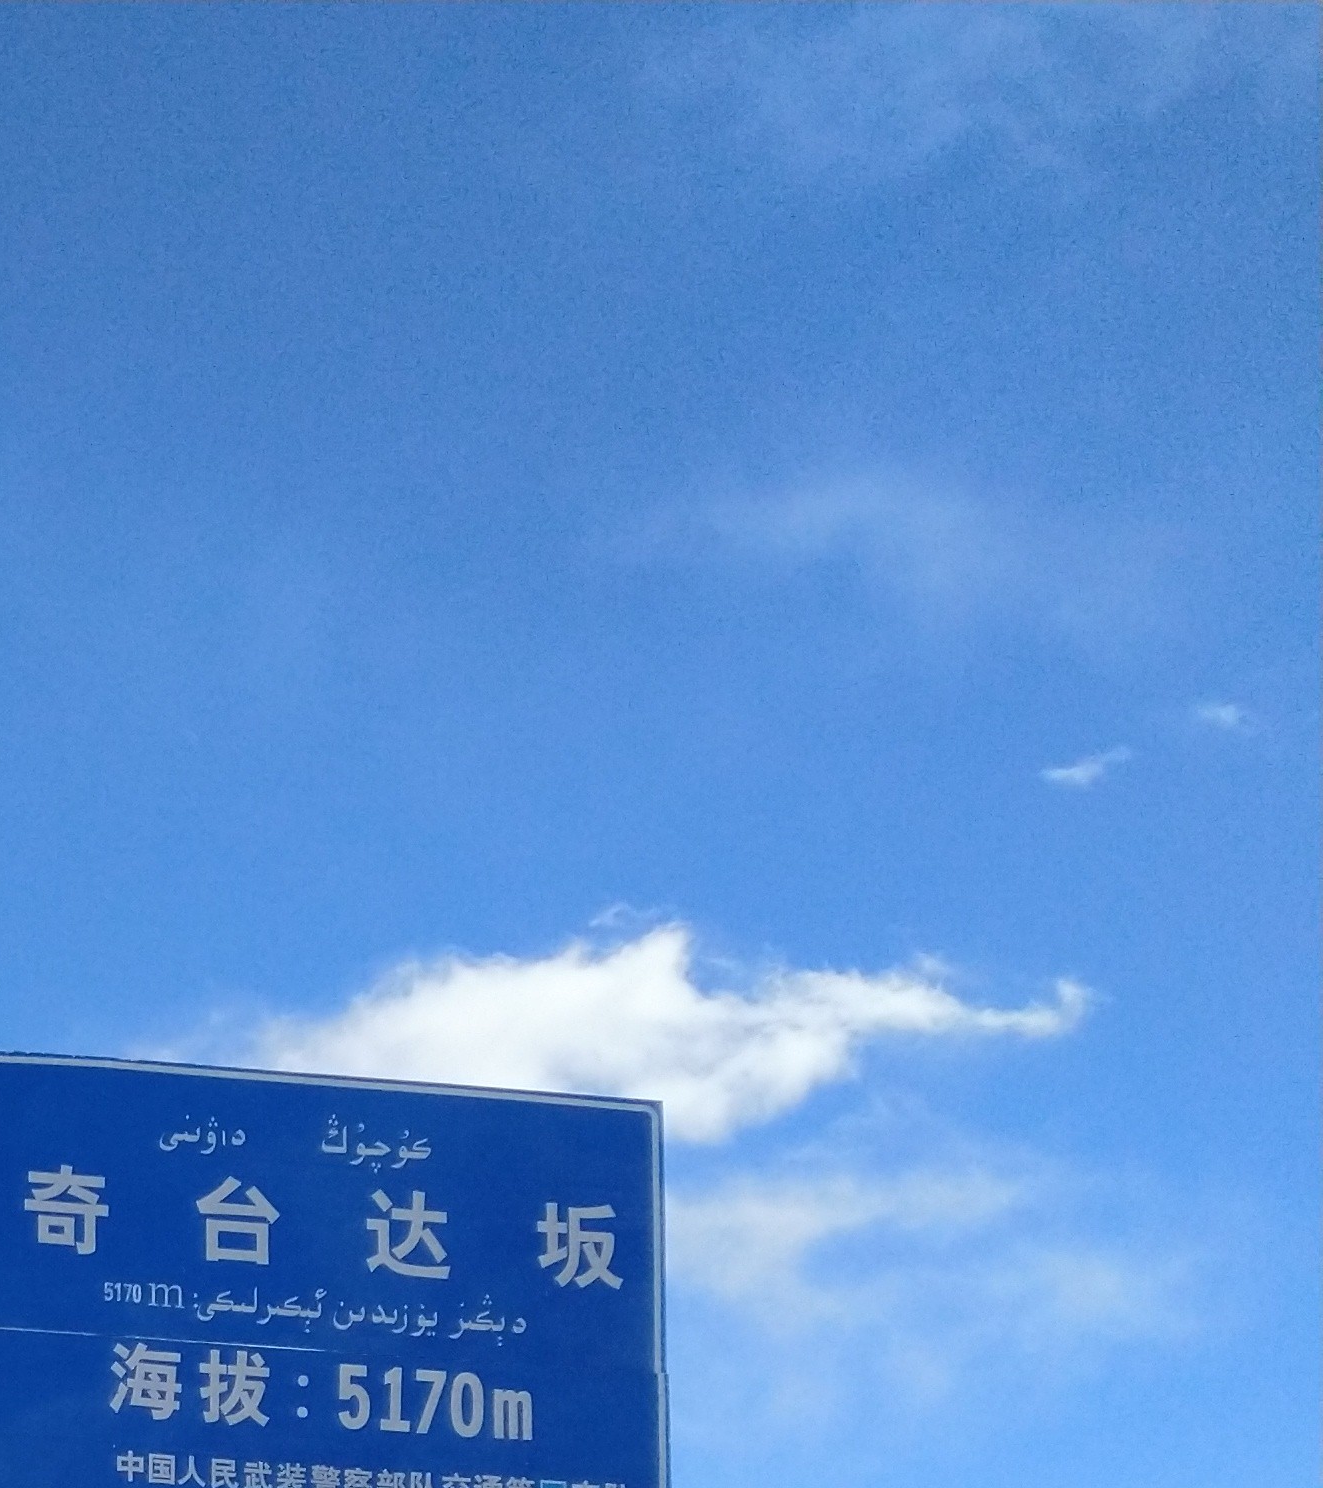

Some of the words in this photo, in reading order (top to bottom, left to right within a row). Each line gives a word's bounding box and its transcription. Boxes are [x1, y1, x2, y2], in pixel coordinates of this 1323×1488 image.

[23, 1164, 625, 1290] 奇台达坂
[103, 1281, 143, 1304] 5170
[148, 1282, 185, 1309] m
